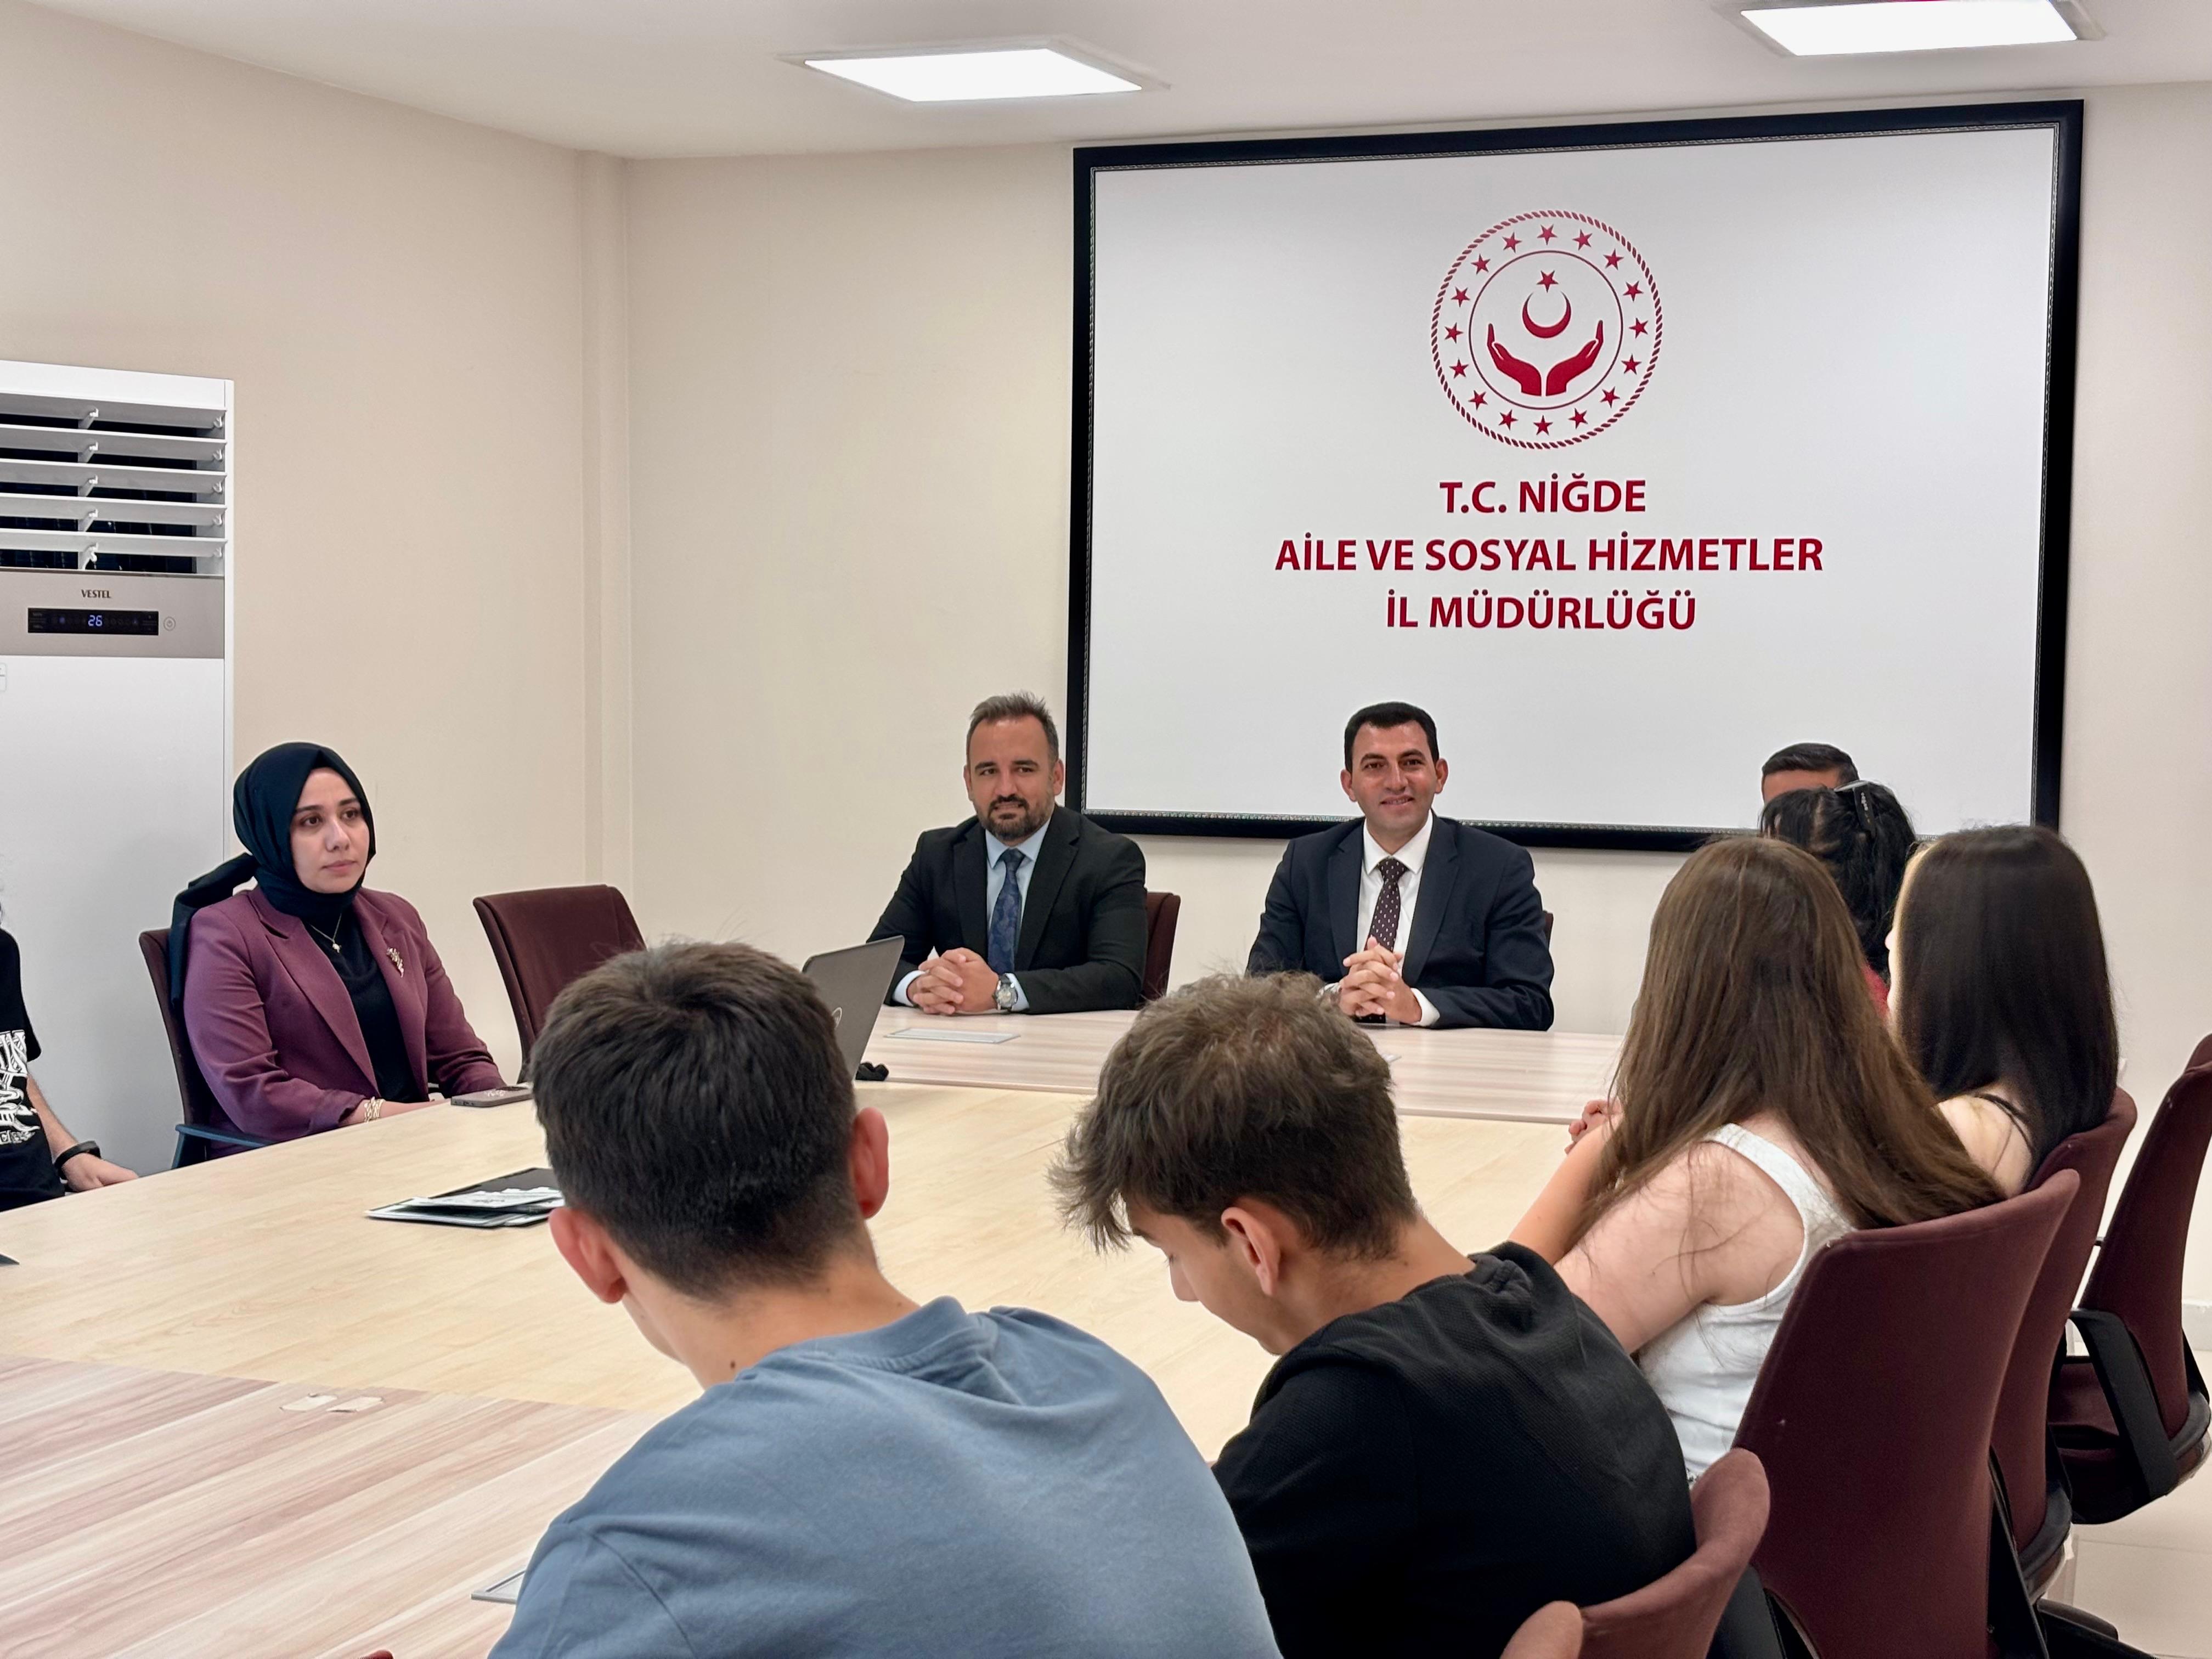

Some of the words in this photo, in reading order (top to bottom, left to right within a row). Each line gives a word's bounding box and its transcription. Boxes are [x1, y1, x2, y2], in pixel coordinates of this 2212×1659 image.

[1438, 480, 1507, 514] T.C.
[1518, 472, 1646, 514] NİĞDE
[1274, 532, 1357, 571] AİLE
[1365, 539, 1414, 571] VE
[1425, 538, 1576, 572] SOSYAL
[1588, 531, 1823, 572] HİZMETLER
[81, 589, 111, 598] VESTEL
[1386, 589, 1419, 628] İL
[1429, 589, 1696, 630] MÜDÜRLÜĞÜ
[88, 615, 103, 627] 26
